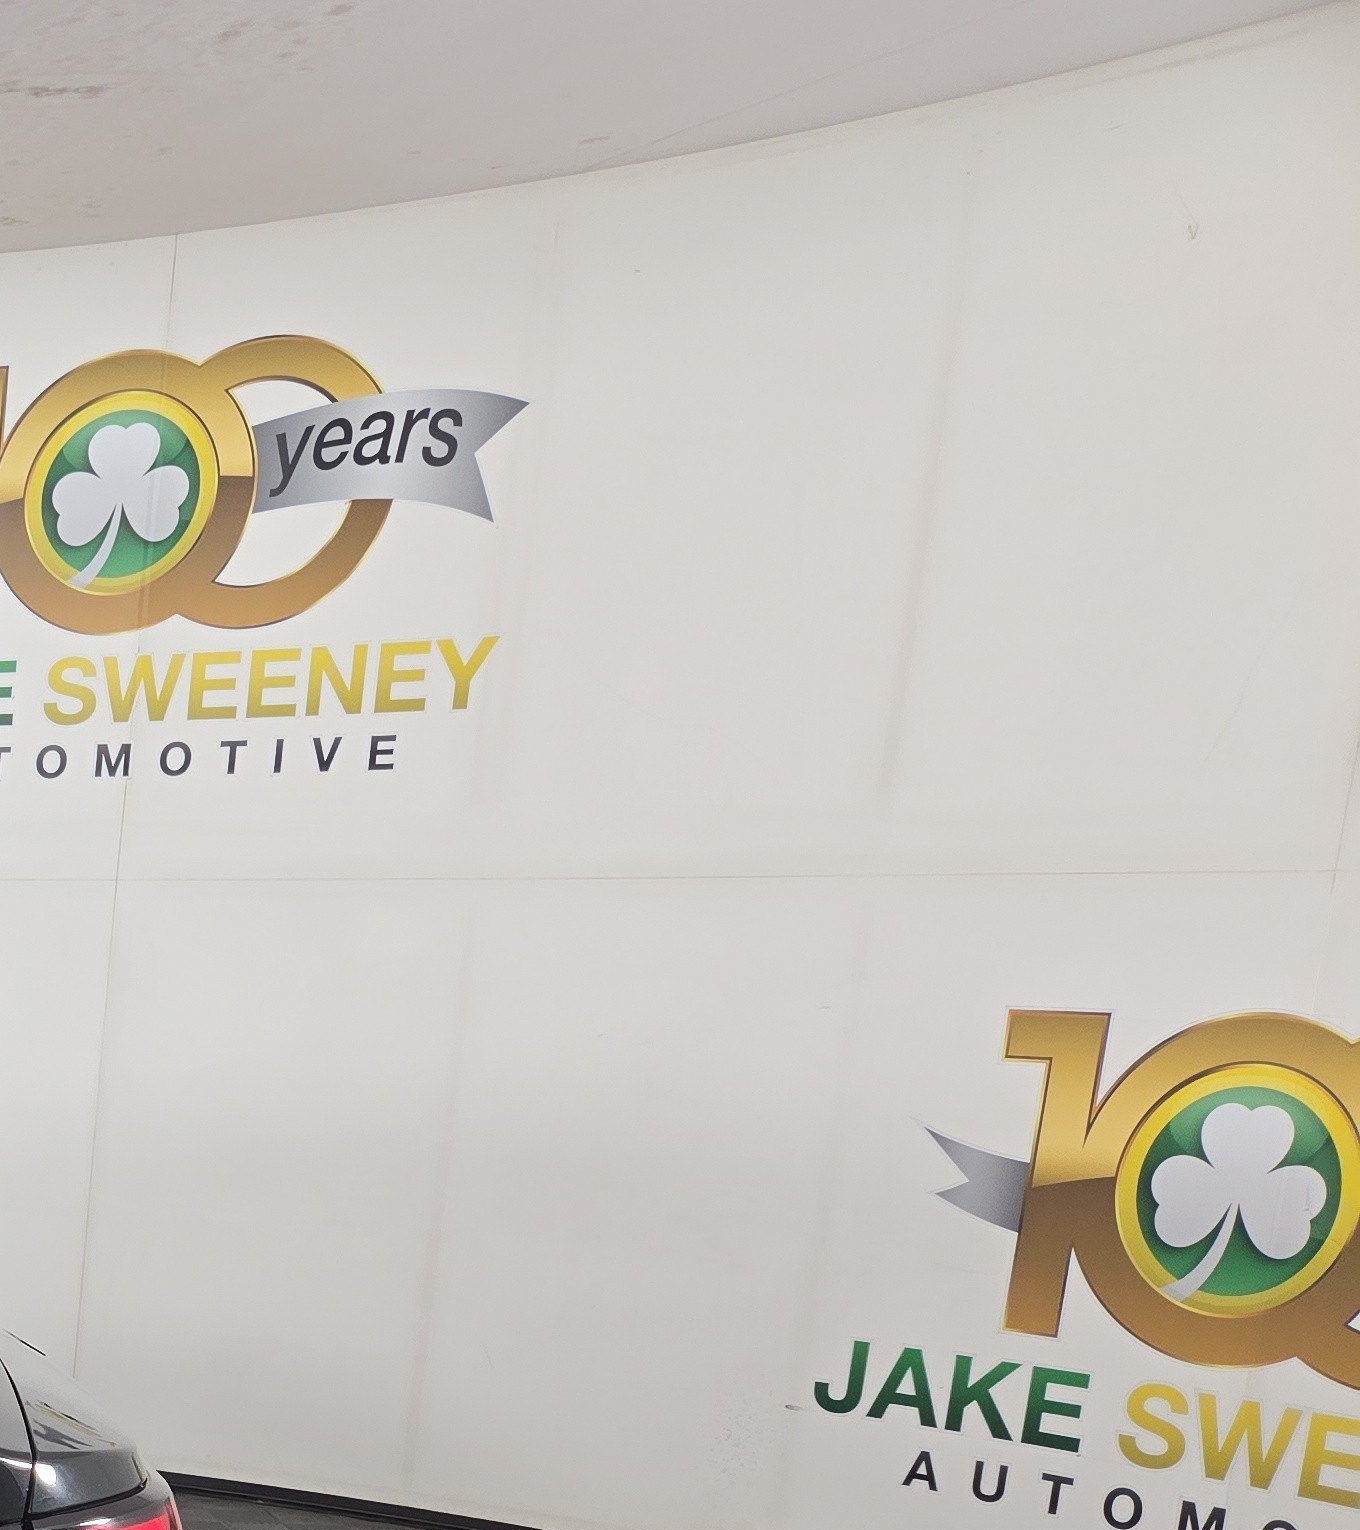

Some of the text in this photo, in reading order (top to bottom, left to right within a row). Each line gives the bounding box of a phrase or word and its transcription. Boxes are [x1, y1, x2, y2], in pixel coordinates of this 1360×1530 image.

[269, 406, 463, 498] years
[43, 635, 500, 725] SWEENEY
[1002, 1008, 1360, 1390] 10
[813, 1340, 1091, 1453] JAKE
